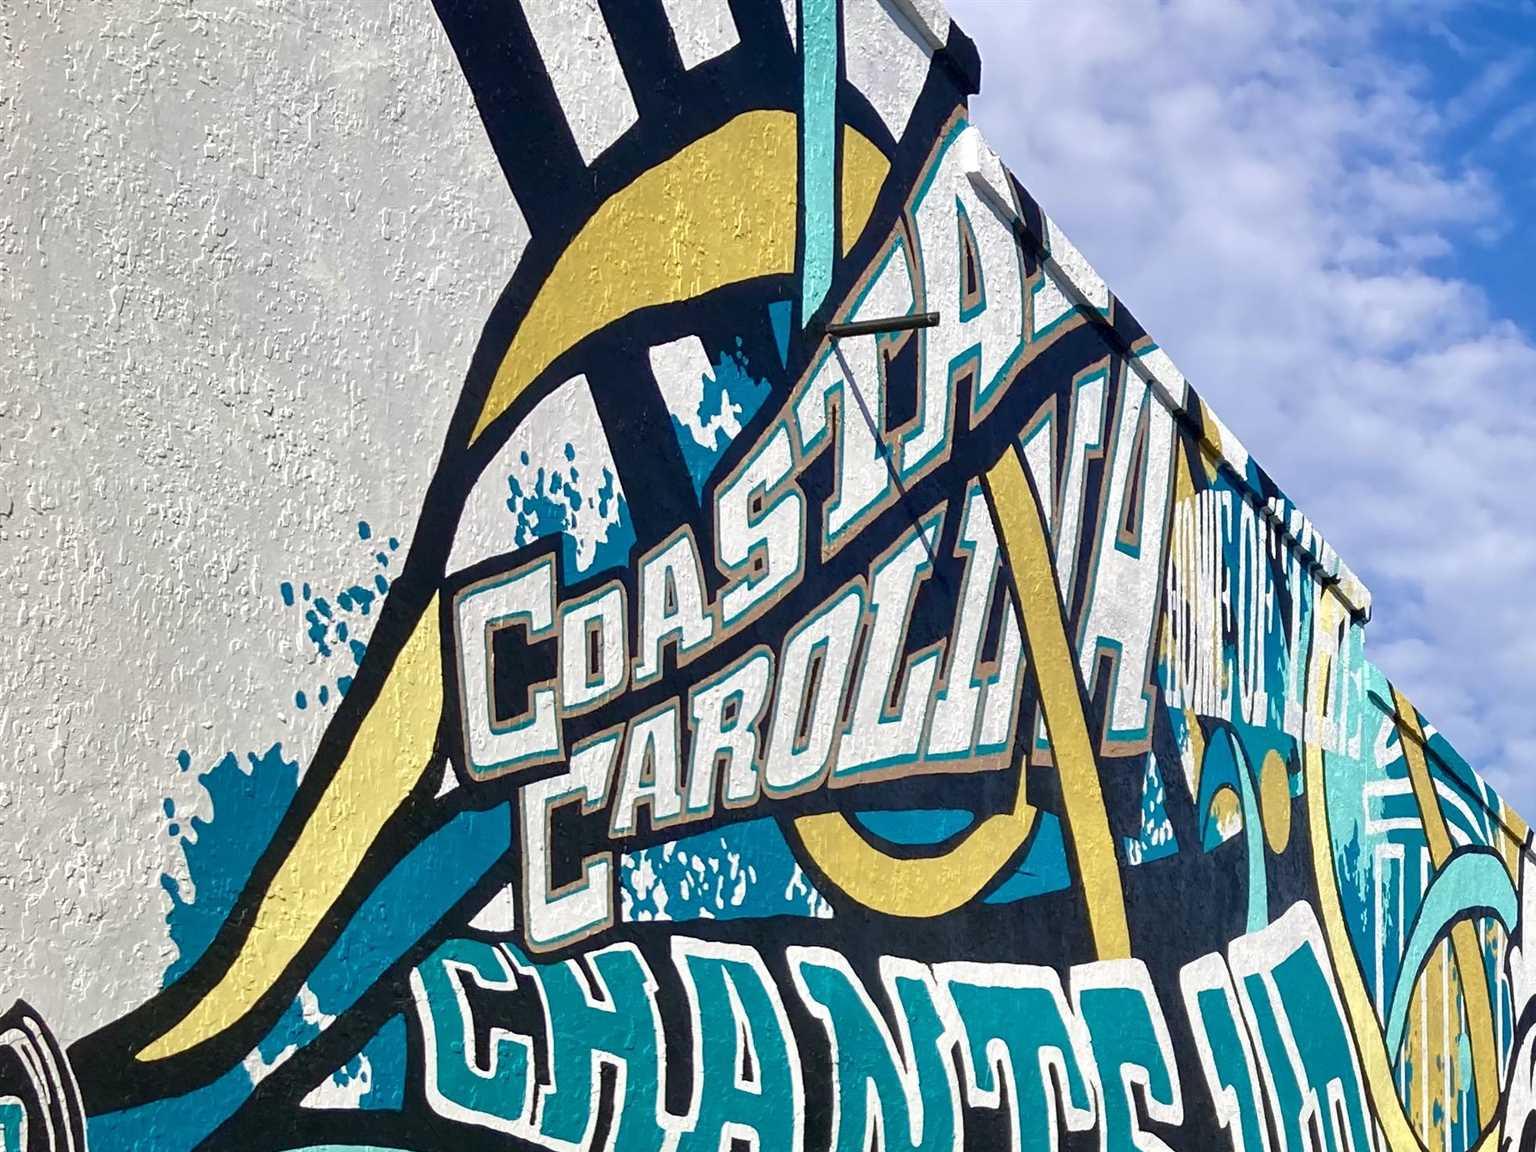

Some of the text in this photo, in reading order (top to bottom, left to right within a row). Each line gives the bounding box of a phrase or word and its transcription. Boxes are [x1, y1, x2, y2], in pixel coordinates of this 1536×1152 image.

[455, 108, 1113, 780] COASTAL
[518, 338, 1188, 952] CAROLINA
[1164, 489, 1233, 719] HOME
